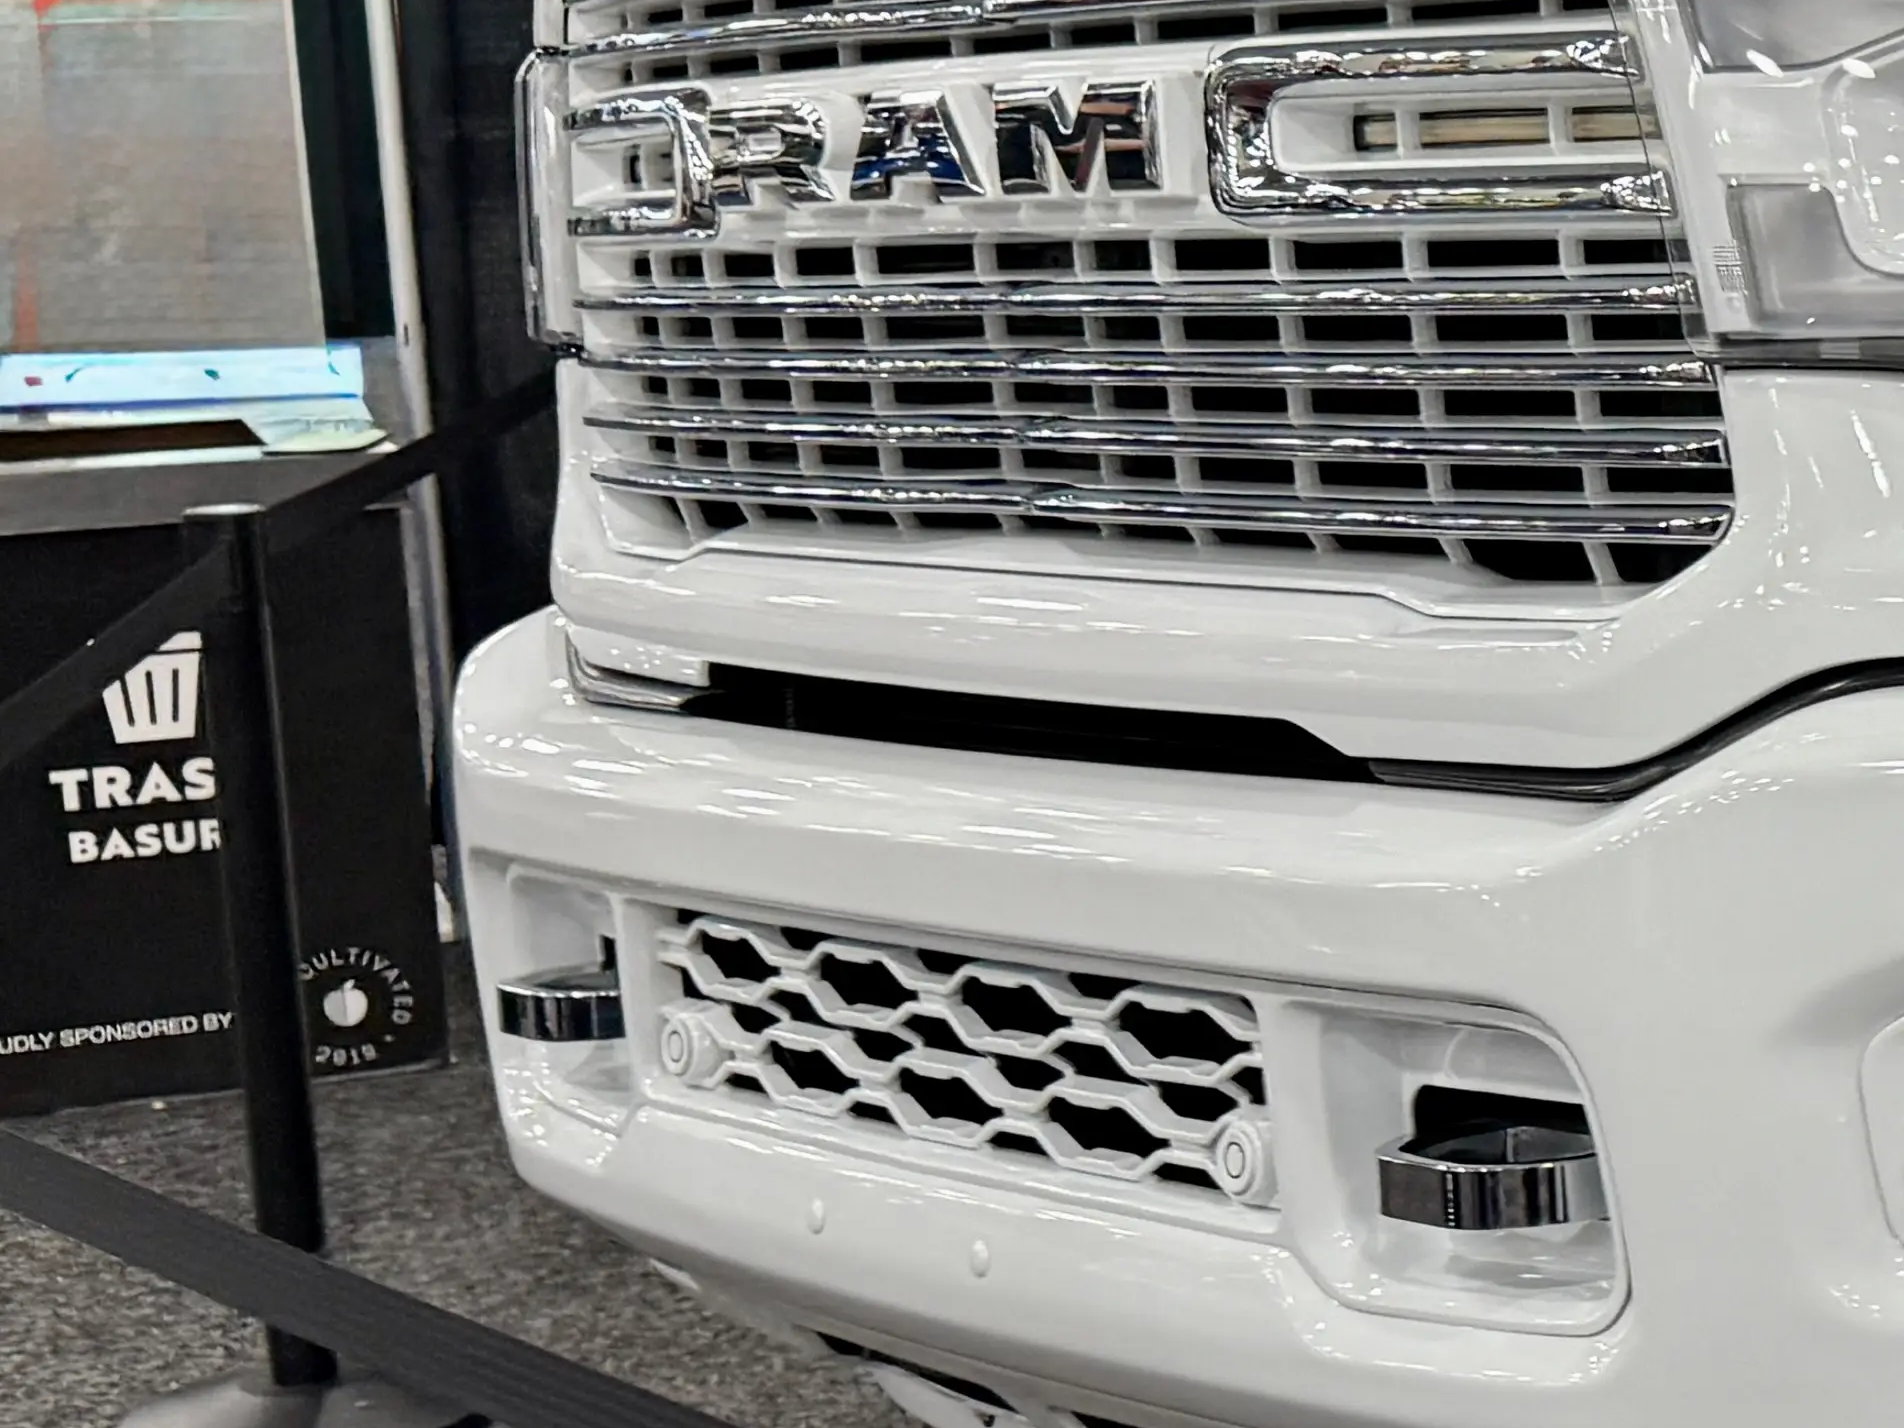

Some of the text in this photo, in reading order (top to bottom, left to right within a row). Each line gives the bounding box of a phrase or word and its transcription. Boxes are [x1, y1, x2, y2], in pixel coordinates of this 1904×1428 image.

[705, 79, 1163, 206] RAM
[59, 1014, 198, 1048] SPONSORED
[202, 1010, 234, 1032] BY
